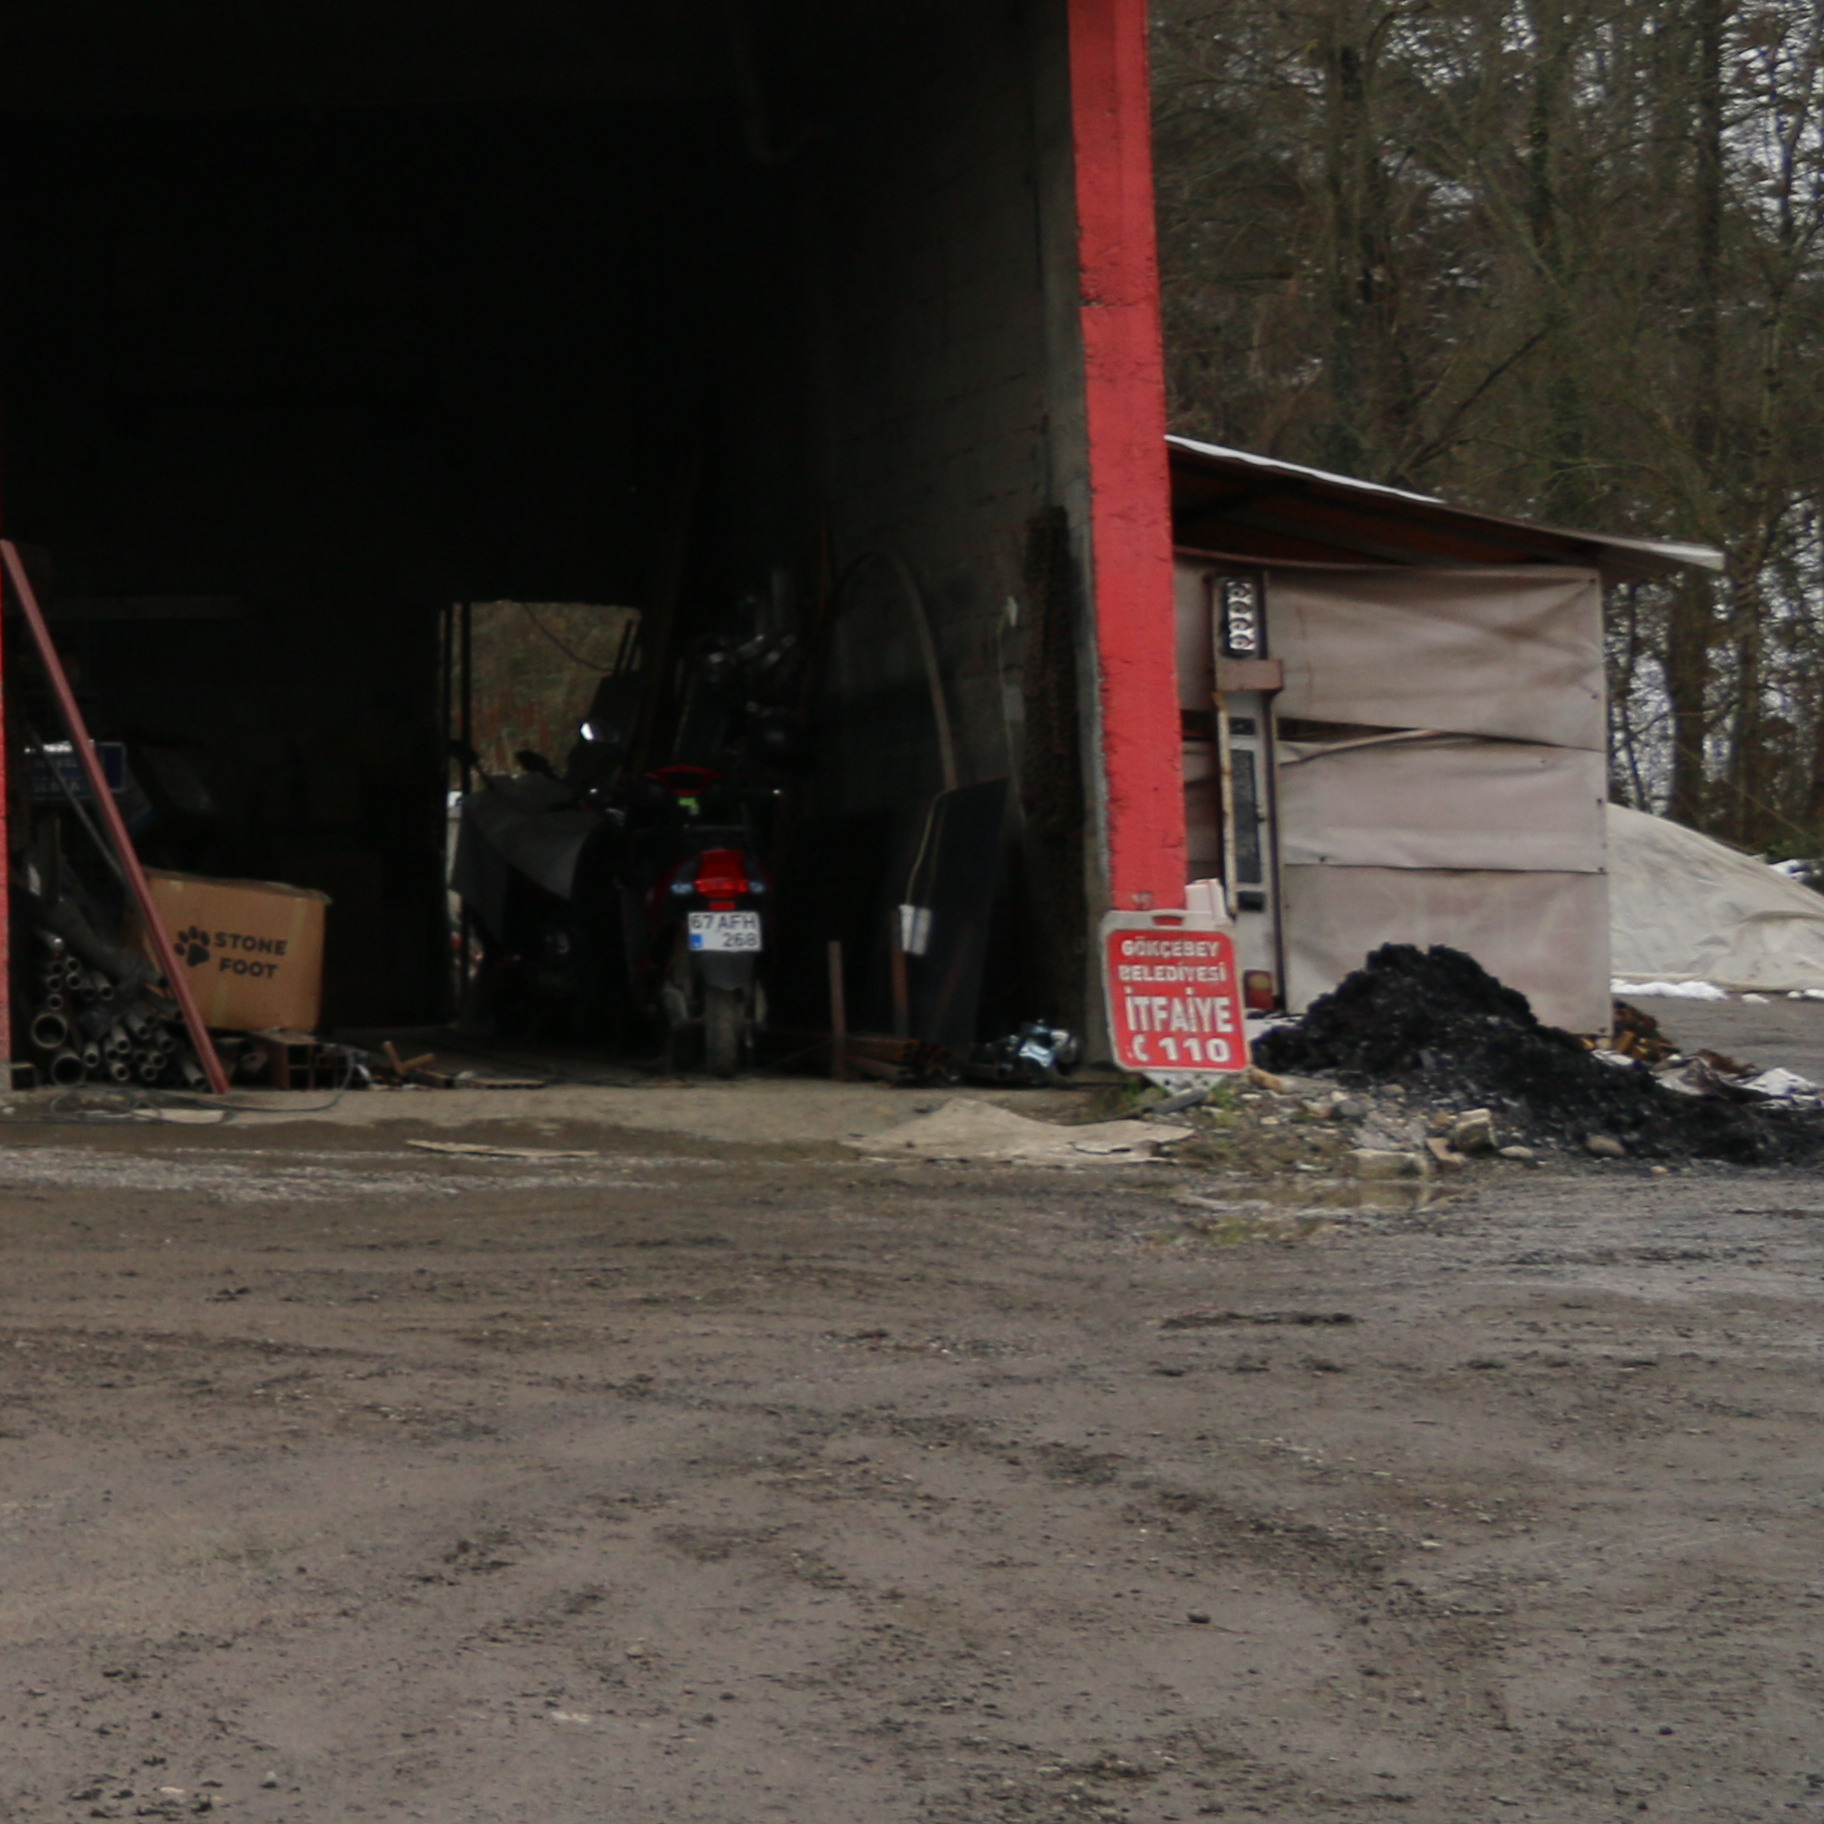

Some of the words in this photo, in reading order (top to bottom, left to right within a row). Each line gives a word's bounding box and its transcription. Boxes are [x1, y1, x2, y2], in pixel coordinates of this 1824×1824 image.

[692, 914, 713, 929] 67
[214, 931, 288, 956] STONE
[1121, 936, 1220, 958] GÖKÇEBEY
[219, 957, 279, 978] FOOT
[1118, 961, 1227, 982] BELEDİYESİ
[1123, 986, 1234, 1033] İTFAİYE
[1158, 1036, 1231, 1063] 110
